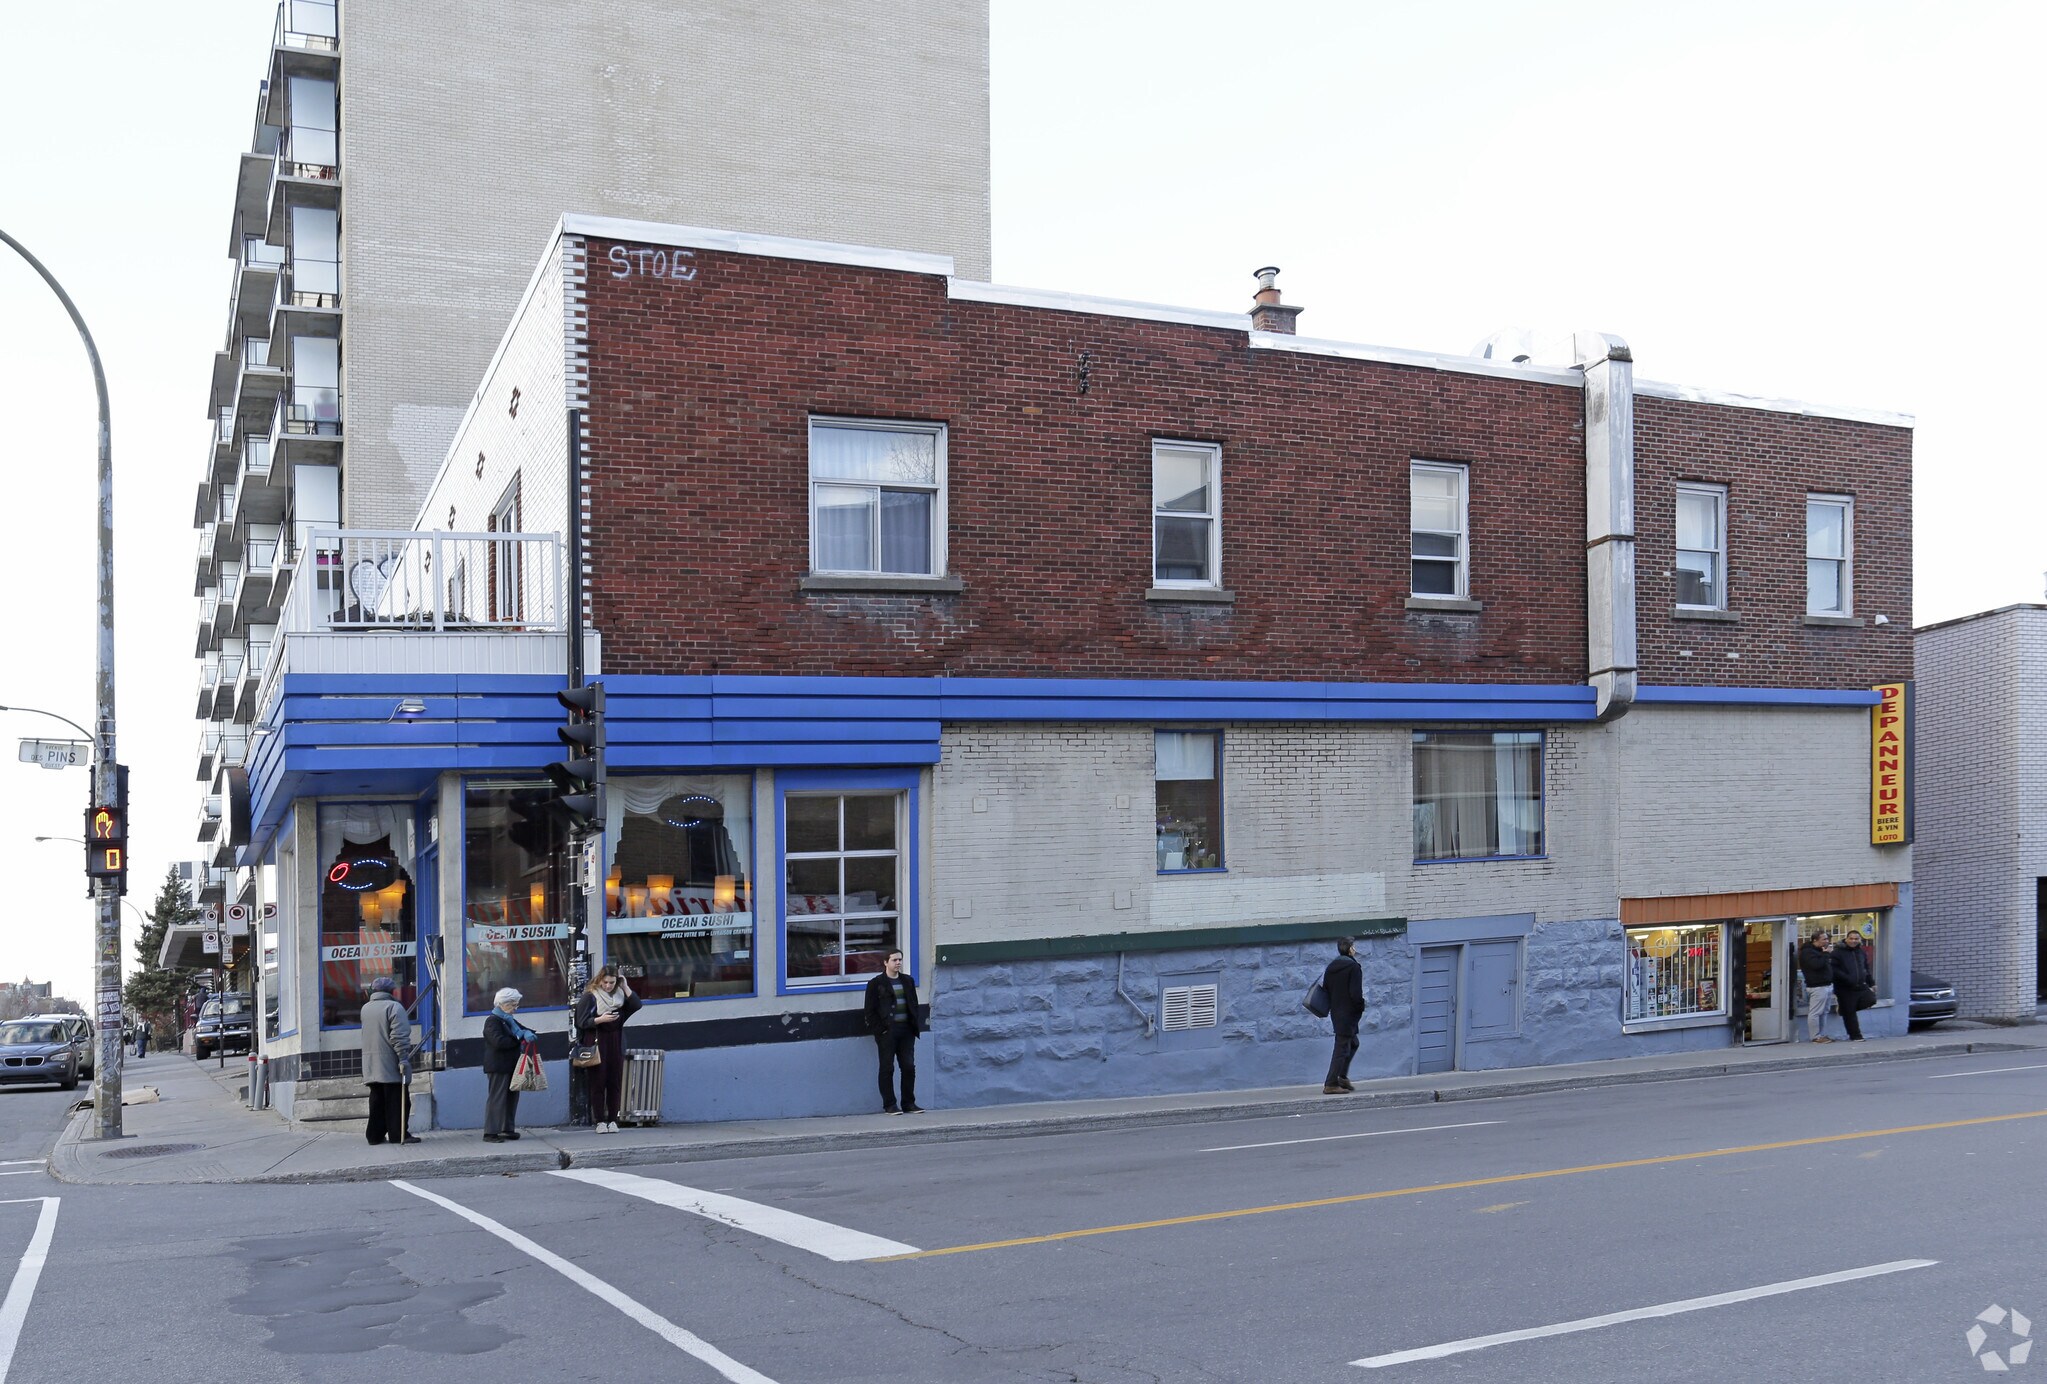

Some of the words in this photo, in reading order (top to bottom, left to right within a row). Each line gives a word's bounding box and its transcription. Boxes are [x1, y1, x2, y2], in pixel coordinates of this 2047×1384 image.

[48, 751, 76, 763] PINS
[1879, 687, 1899, 815] DEPANNEUR
[1877, 817, 1899, 825] BIERE
[662, 917, 698, 929] OCEAN
[701, 915, 734, 927] SUSHI
[482, 928, 518, 940] CEAN
[521, 926, 556, 938] SUSHI
[661, 931, 683, 939] APPORTEZ
[331, 946, 370, 958] OCEAN
[373, 944, 407, 956] SUSHI
